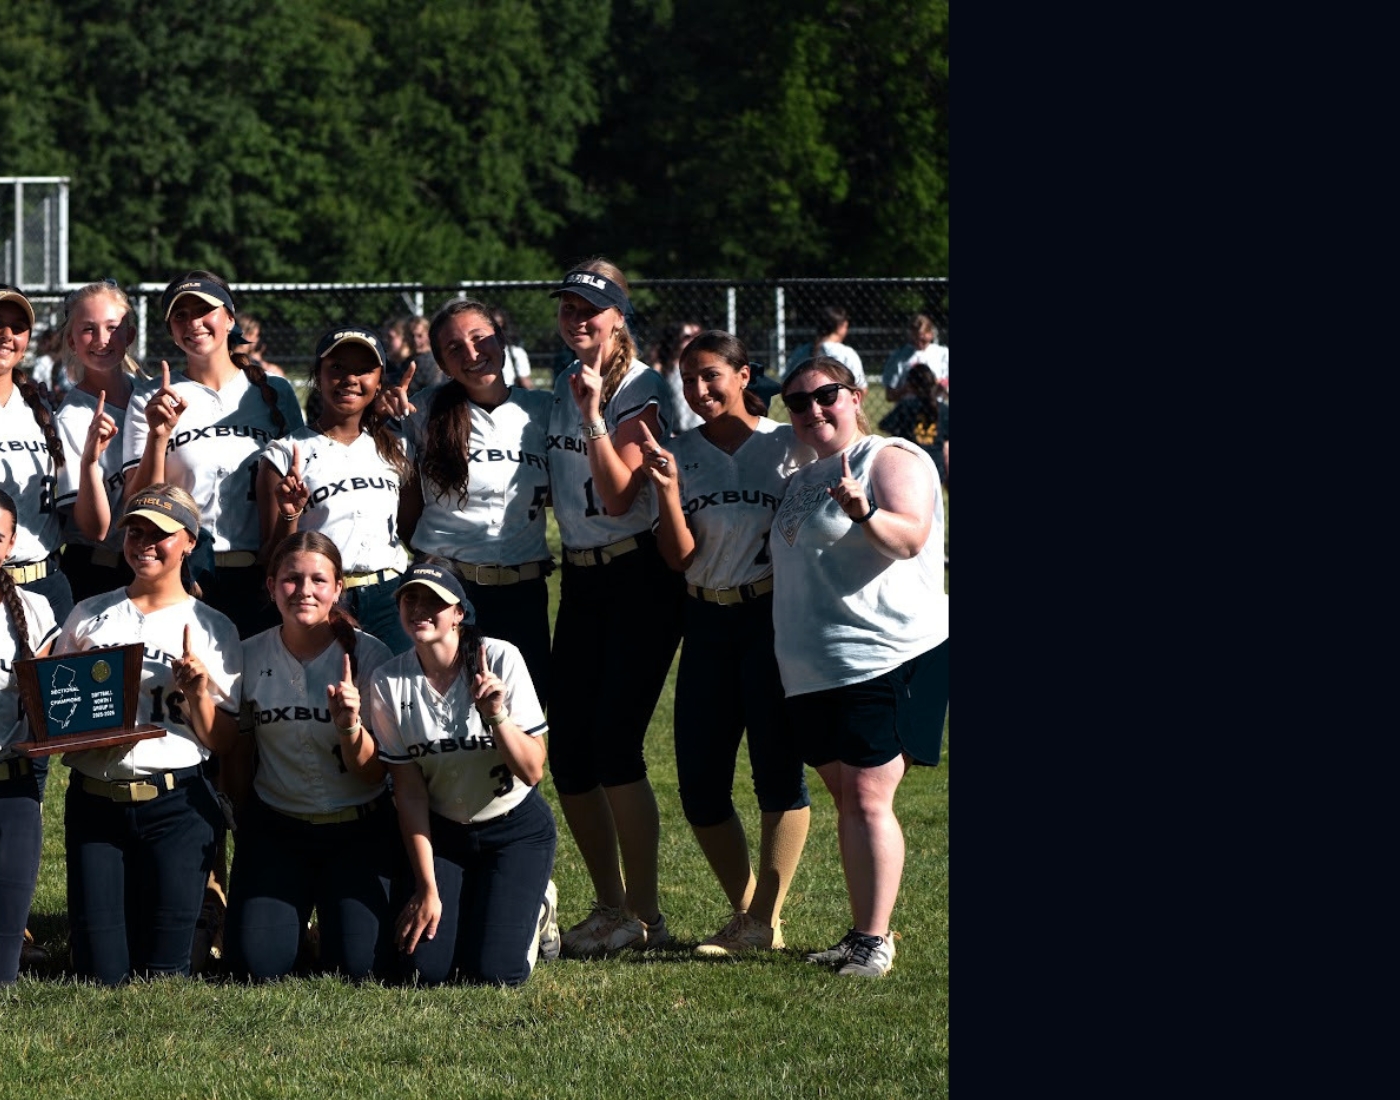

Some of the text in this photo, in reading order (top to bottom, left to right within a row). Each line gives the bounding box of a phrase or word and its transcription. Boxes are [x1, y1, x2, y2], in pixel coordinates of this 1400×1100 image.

[468, 449, 549, 472] XBURY
[528, 485, 547, 521] 5
[684, 490, 781, 516] OXBUR
[50, 686, 80, 695] SECTIONAL
[50, 696, 82, 706] CHAMPIONS
[254, 706, 332, 726] ROXBU
[407, 734, 497, 758] OXBUR
[490, 763, 514, 798] 3
